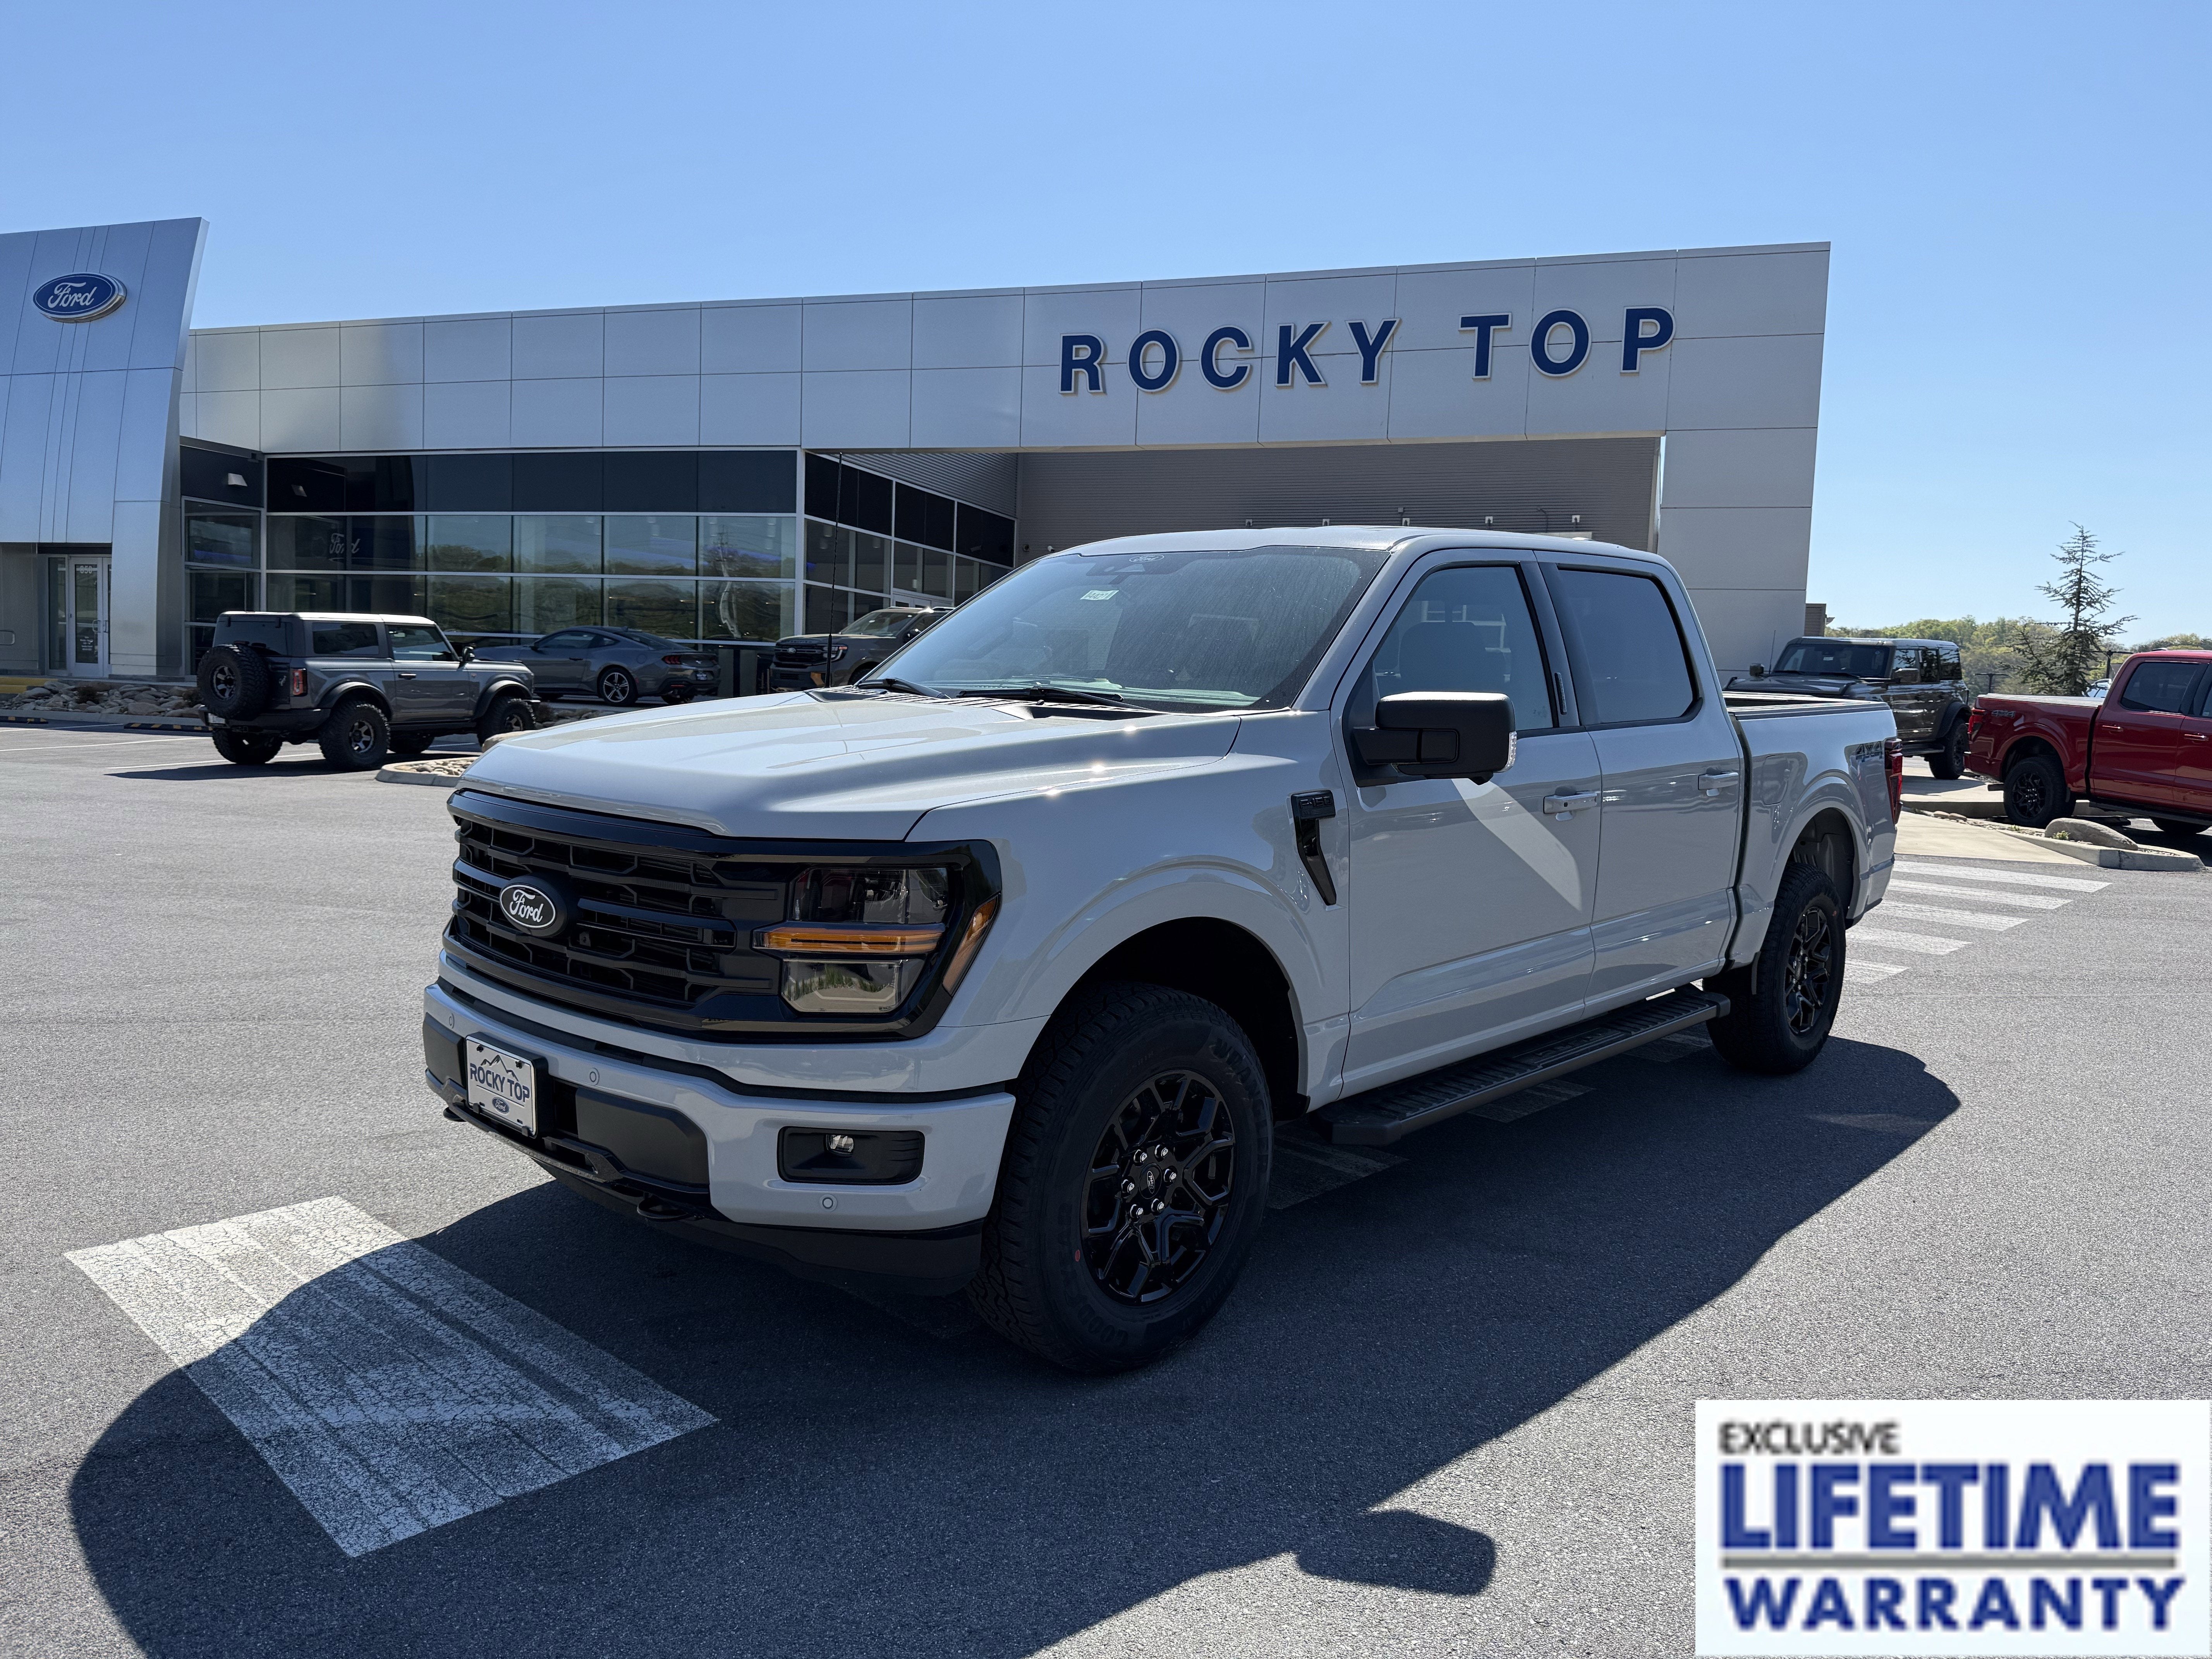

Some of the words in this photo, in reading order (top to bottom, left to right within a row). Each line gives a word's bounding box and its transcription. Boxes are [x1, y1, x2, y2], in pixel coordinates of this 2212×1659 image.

[47, 282, 98, 308] Ford
[1059, 318, 1401, 394] ROCKY
[1459, 305, 1676, 380] TOP
[1299, 796, 1333, 809] F-150
[510, 889, 544, 922] Ford
[470, 1063, 505, 1093] ROCKY
[507, 1079, 530, 1103] TOP
[495, 1099, 506, 1111] Ford
